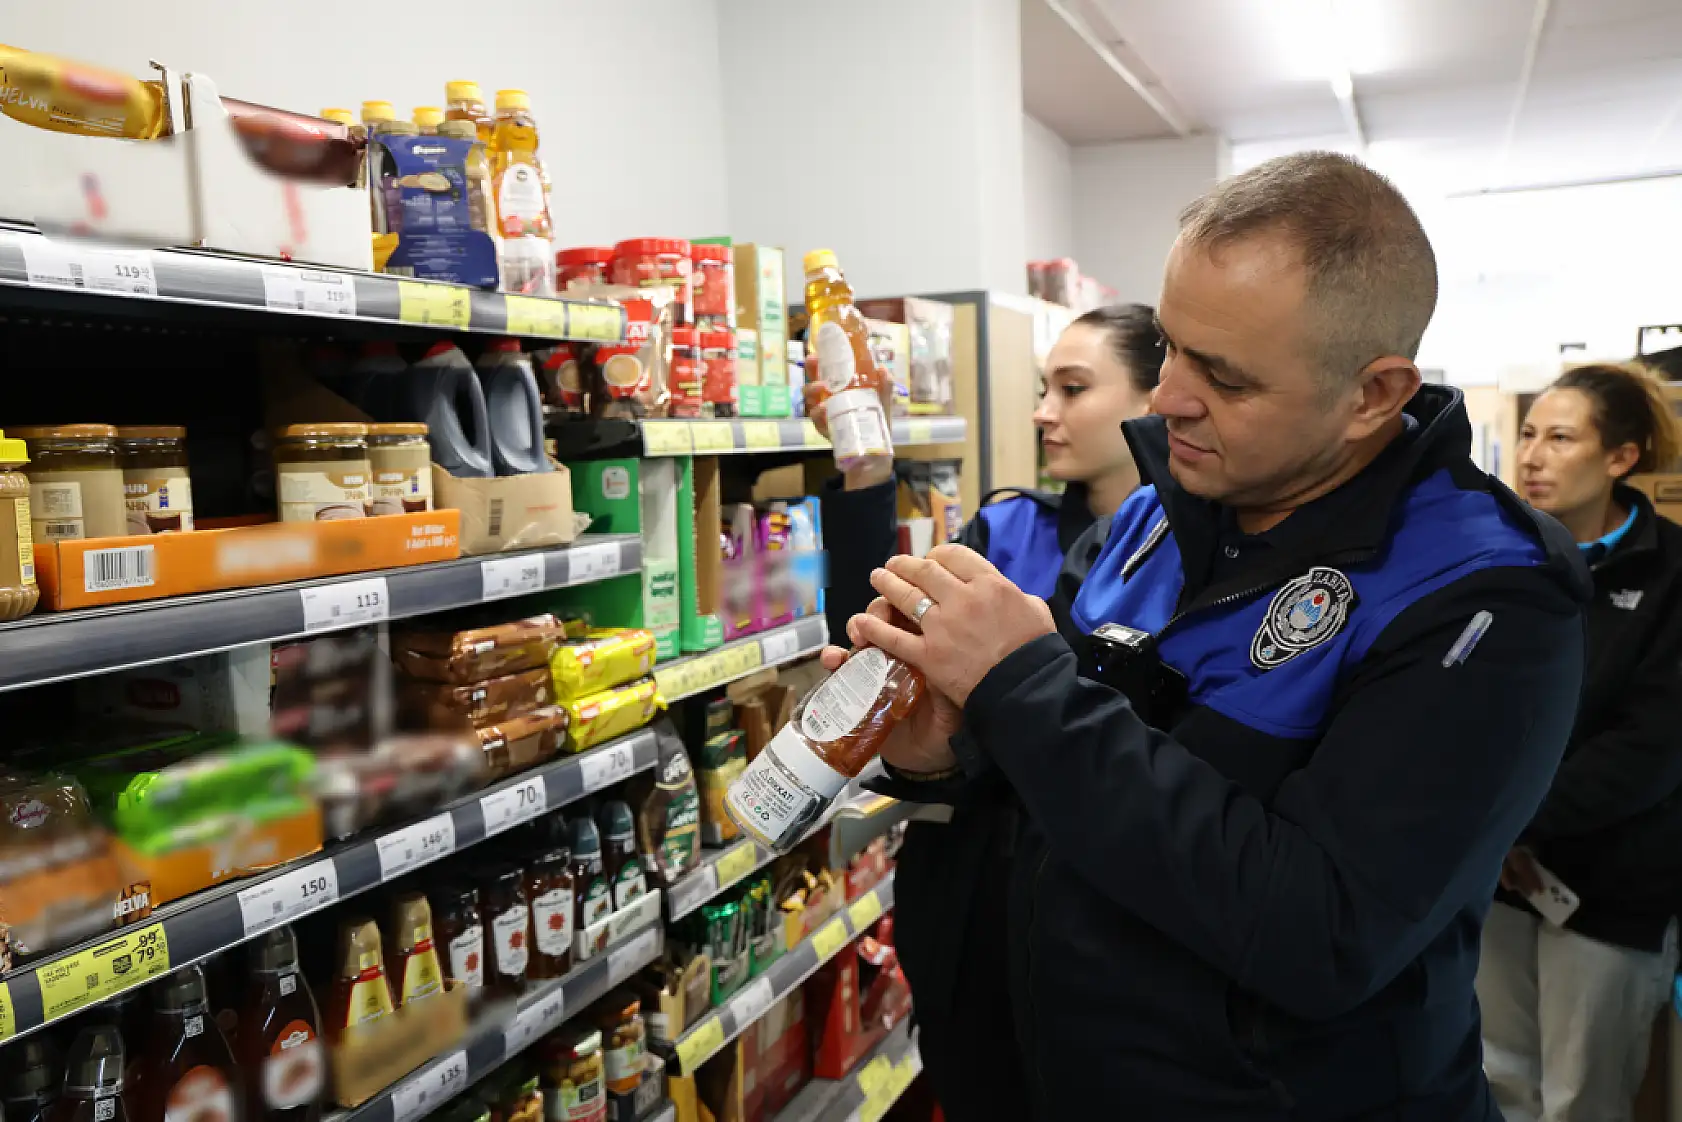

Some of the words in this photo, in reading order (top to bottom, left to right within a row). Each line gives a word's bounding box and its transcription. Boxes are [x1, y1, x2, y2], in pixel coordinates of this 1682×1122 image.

[357, 591, 379, 608] 113
[516, 784, 536, 808] 70
[300, 876, 327, 898] 150
[136, 946, 155, 963] 79
